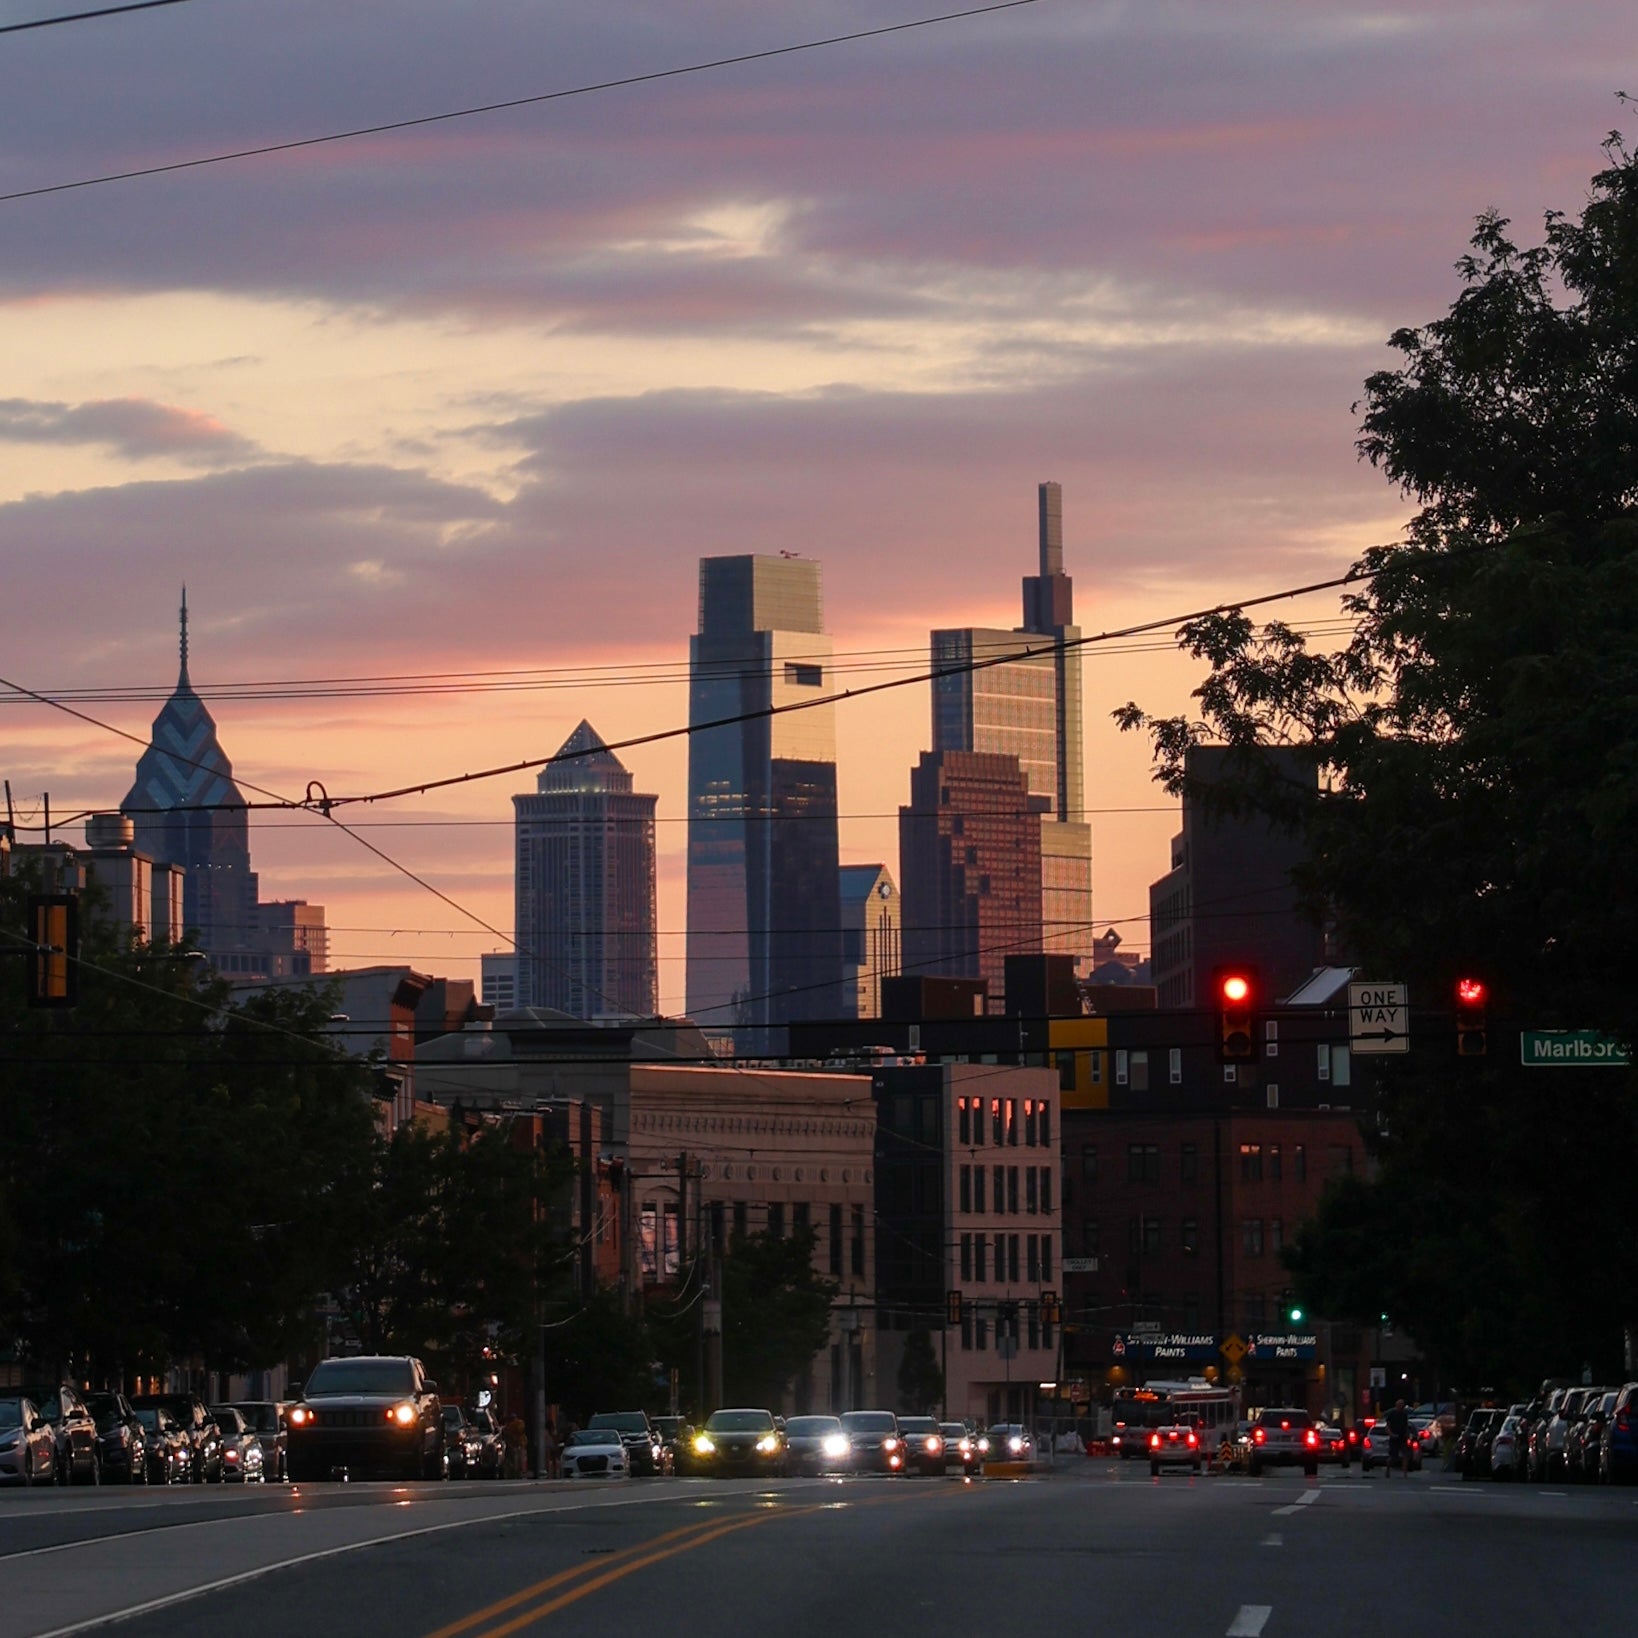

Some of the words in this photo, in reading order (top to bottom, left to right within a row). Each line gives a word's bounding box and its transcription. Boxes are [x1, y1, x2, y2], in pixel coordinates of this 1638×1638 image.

[1361, 991, 1396, 1005] ONE
[1361, 1009, 1397, 1022] WAY
[1155, 1347, 1186, 1357] PAINTS
[1276, 1346, 1297, 1357] PAINTS
